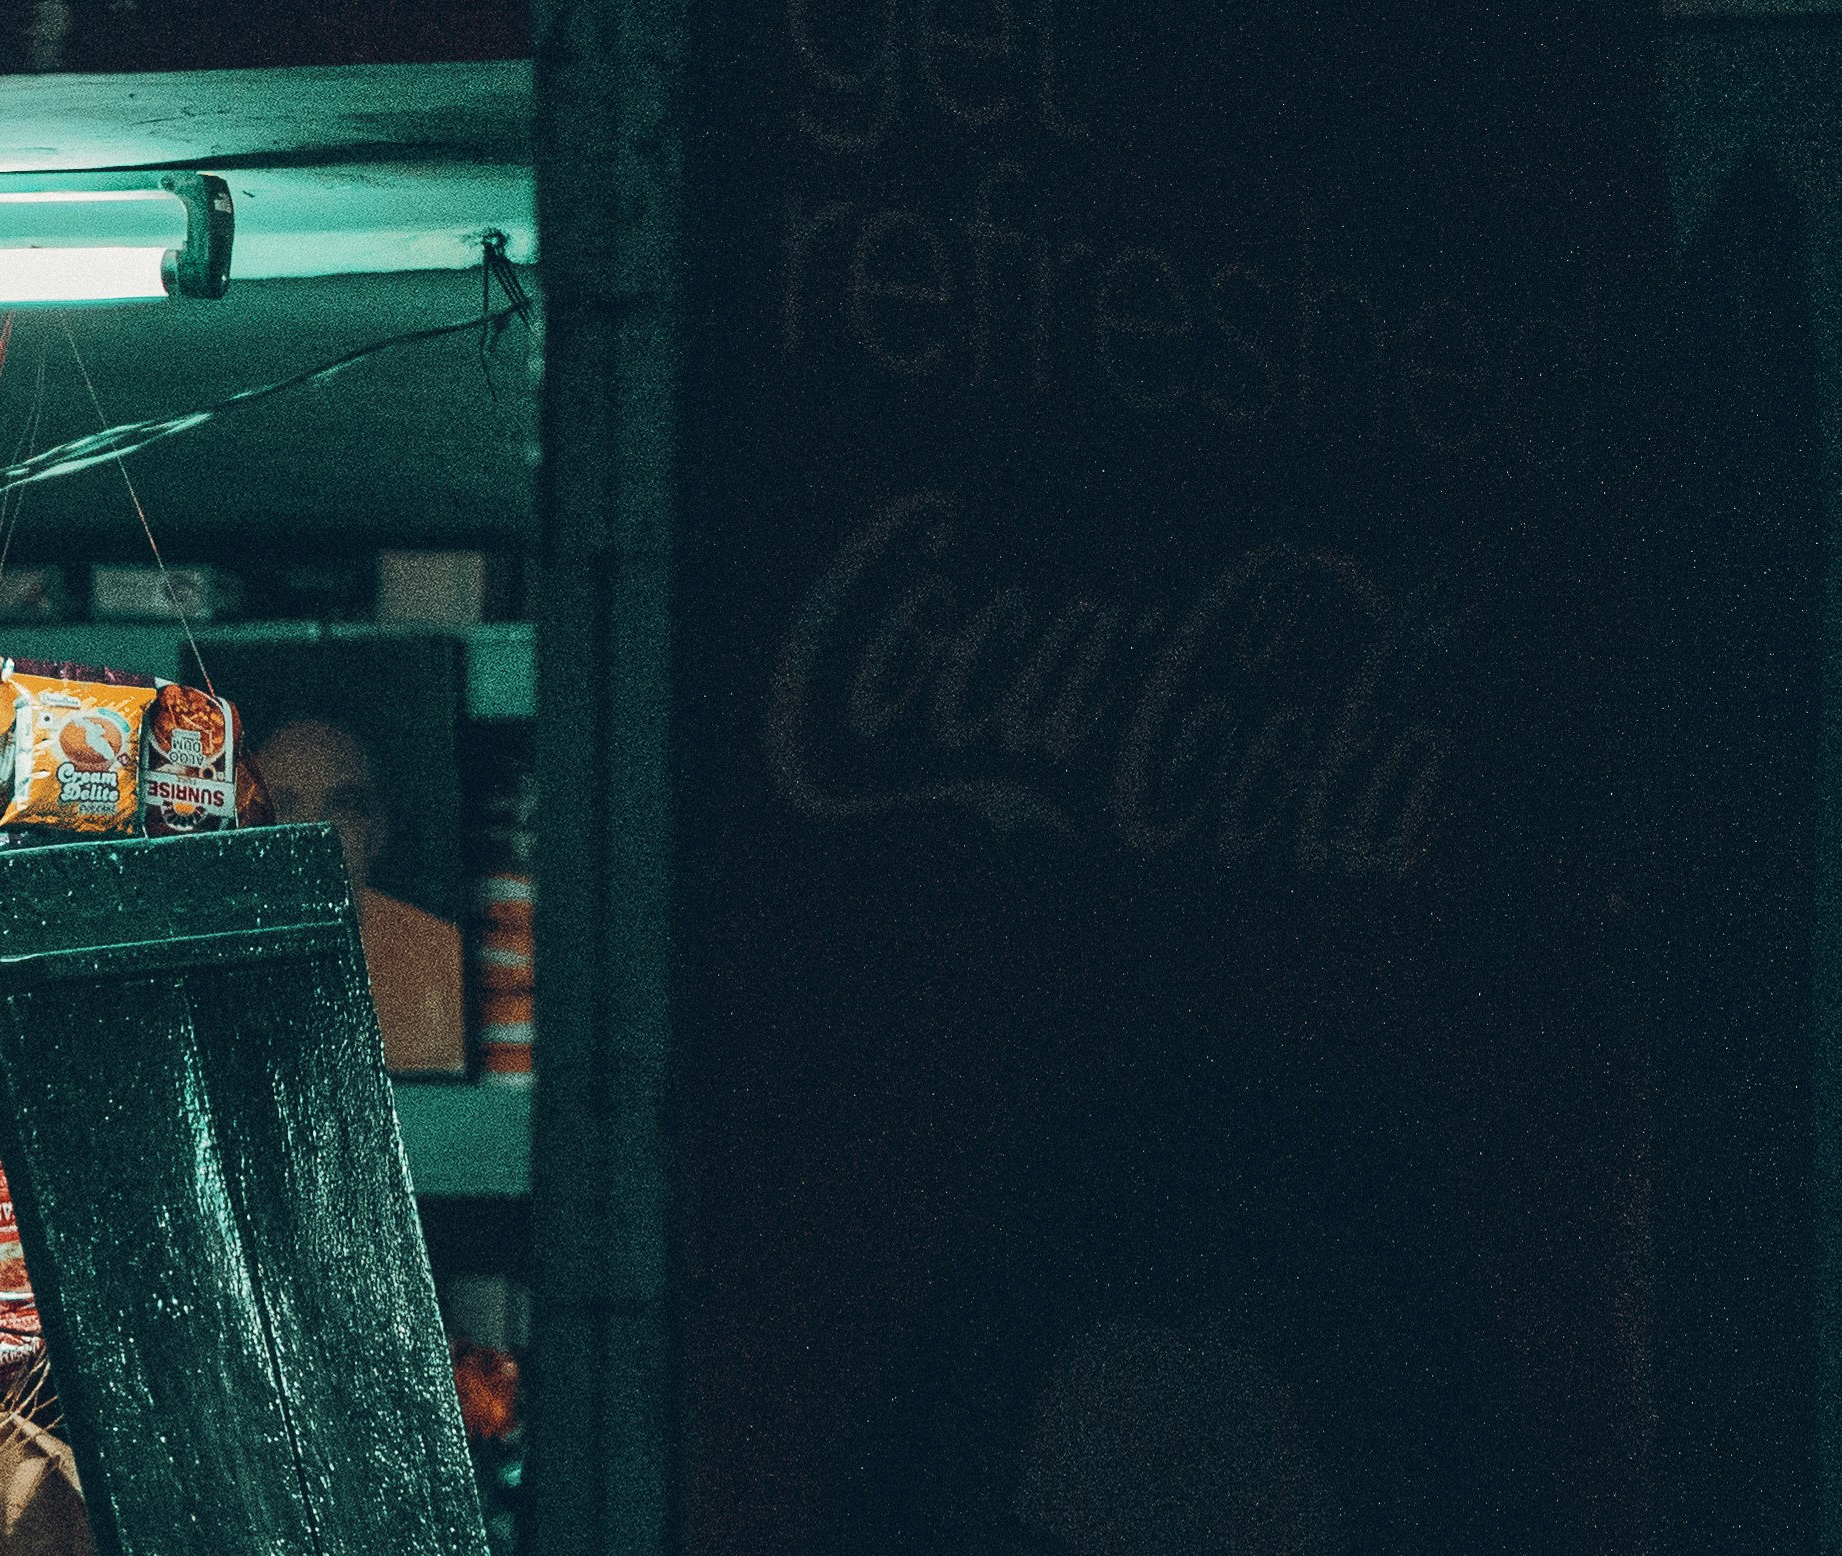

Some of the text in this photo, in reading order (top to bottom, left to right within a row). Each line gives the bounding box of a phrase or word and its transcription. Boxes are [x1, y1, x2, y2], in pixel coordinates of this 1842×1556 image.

[57, 762, 118, 788] Cream
[60, 783, 120, 803] Delite
[146, 780, 225, 808] SUNRISE
